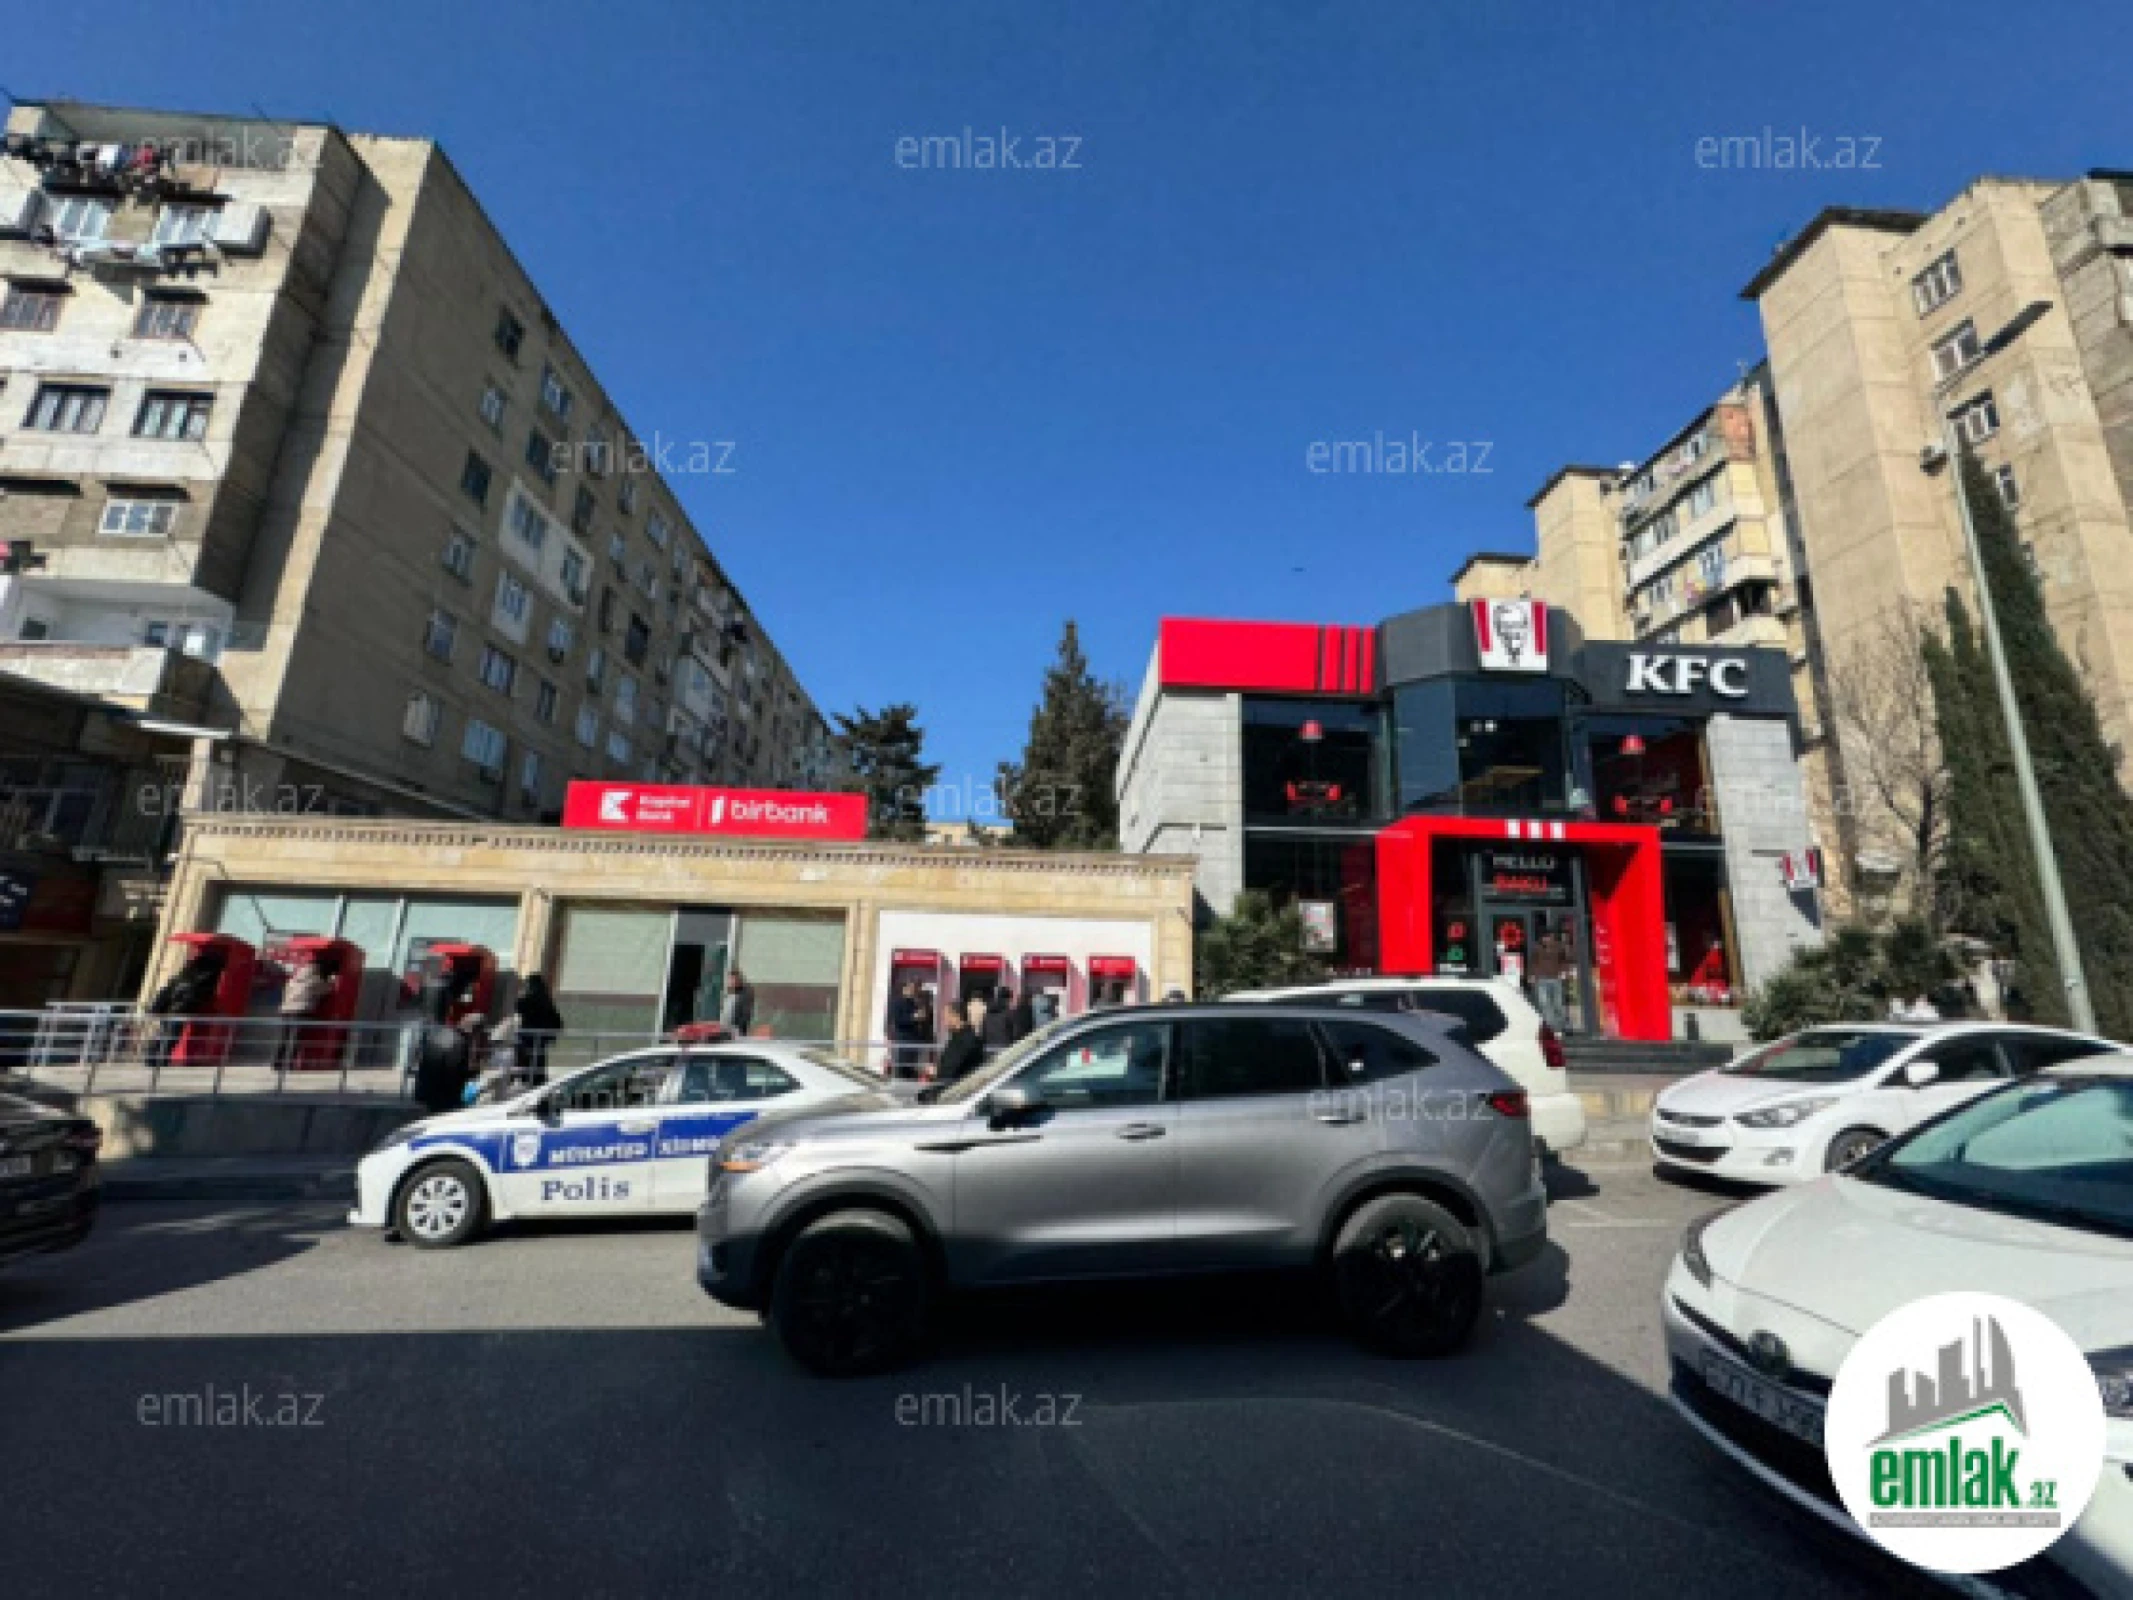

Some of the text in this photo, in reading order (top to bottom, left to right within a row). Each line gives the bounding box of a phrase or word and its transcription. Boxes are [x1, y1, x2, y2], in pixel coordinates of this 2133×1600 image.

[1625, 654, 1749, 697] KFC
[730, 799, 830, 825] birbank
[540, 1176, 631, 1202] Polis
